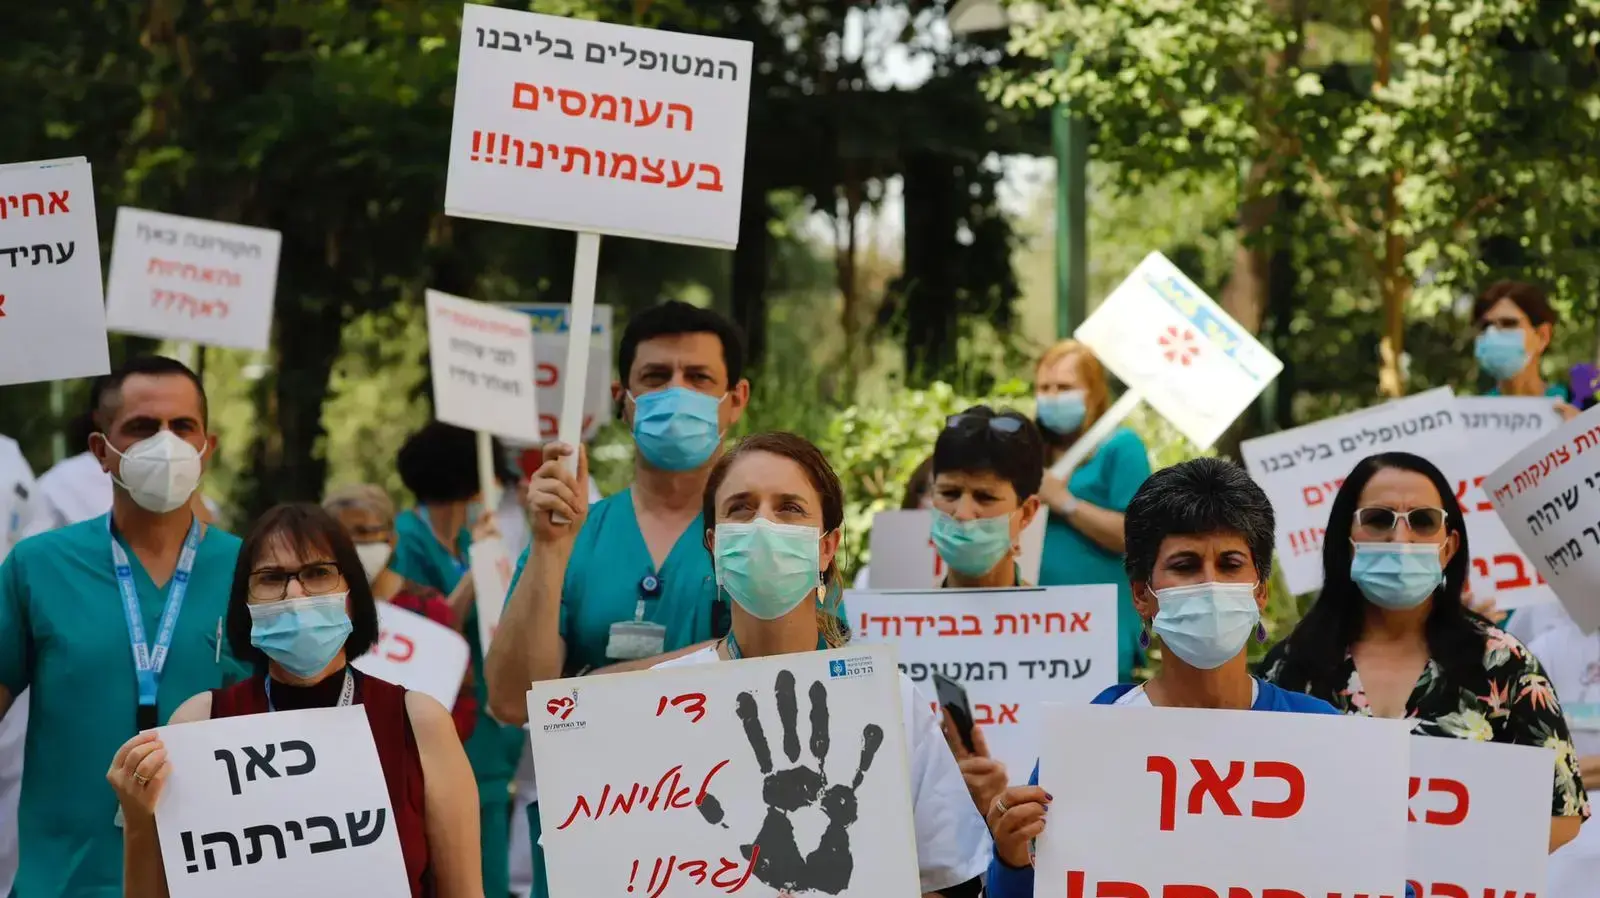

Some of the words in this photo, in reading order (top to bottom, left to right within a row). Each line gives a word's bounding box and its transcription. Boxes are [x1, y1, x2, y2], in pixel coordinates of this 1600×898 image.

[476, 27, 574, 60] בליבנו
[585, 41, 738, 81] המטופלים
[512, 81, 693, 131] העומסים
[470, 130, 723, 192] בעצמותינו!!!
[0, 241, 75, 267] עתיד
[1340, 409, 1452, 454] המטופלים
[1260, 444, 1333, 474] בליבנו
[1513, 444, 1570, 494] צועקות
[1526, 484, 1579, 537] שיהיה
[859, 612, 983, 637] בבידוד!
[993, 611, 1092, 636] אחיות
[847, 666, 874, 676] הדסה
[1018, 657, 1092, 680] עתיד
[656, 692, 707, 723] די
[213, 739, 317, 796] כאן
[556, 760, 730, 830] לאלימות
[1146, 755, 1306, 832] כאן
[180, 807, 387, 874] שביתה!
[627, 844, 761, 898] נגדנו!
